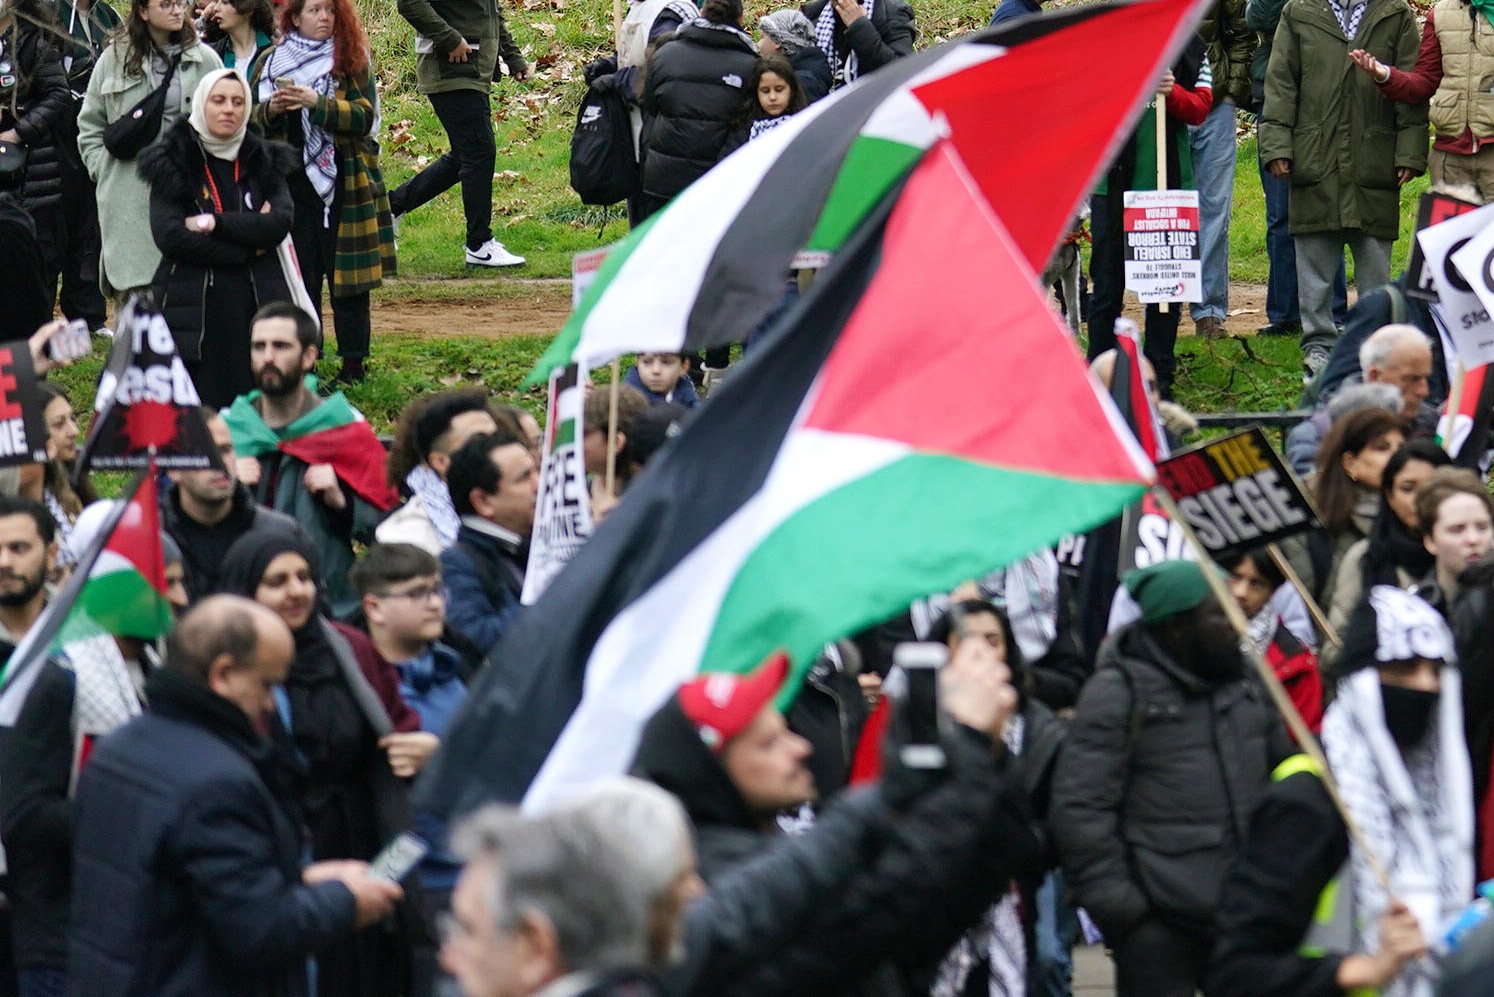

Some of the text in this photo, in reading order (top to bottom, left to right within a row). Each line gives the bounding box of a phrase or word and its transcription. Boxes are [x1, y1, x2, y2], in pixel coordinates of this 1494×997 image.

[1128, 231, 1197, 248] STATE TERROR
[1134, 246, 1193, 261] END ISRAELI
[1205, 432, 1272, 482] THE
[1178, 468, 1307, 551] SIEGE
